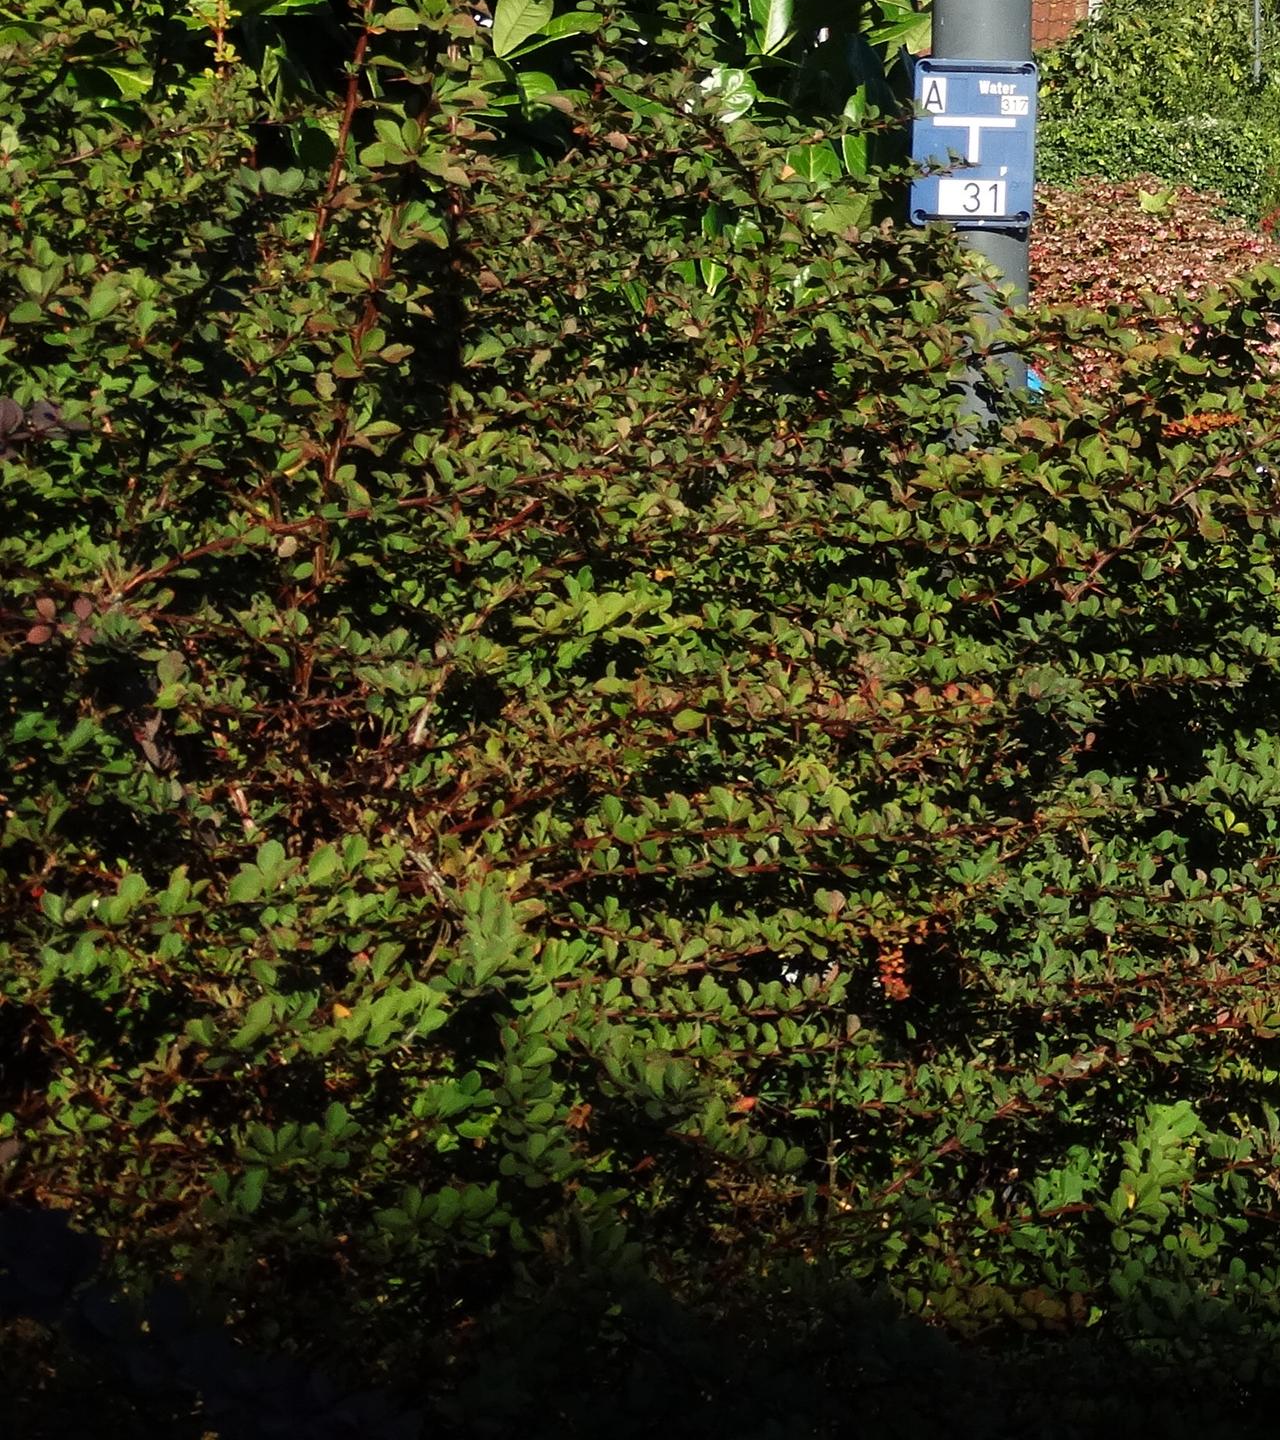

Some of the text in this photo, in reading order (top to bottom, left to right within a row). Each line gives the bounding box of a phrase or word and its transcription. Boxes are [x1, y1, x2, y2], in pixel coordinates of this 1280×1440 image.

[924, 80, 943, 110] A
[979, 80, 1017, 95] Water
[1001, 98, 1028, 112] 317
[962, 182, 998, 213] 31
